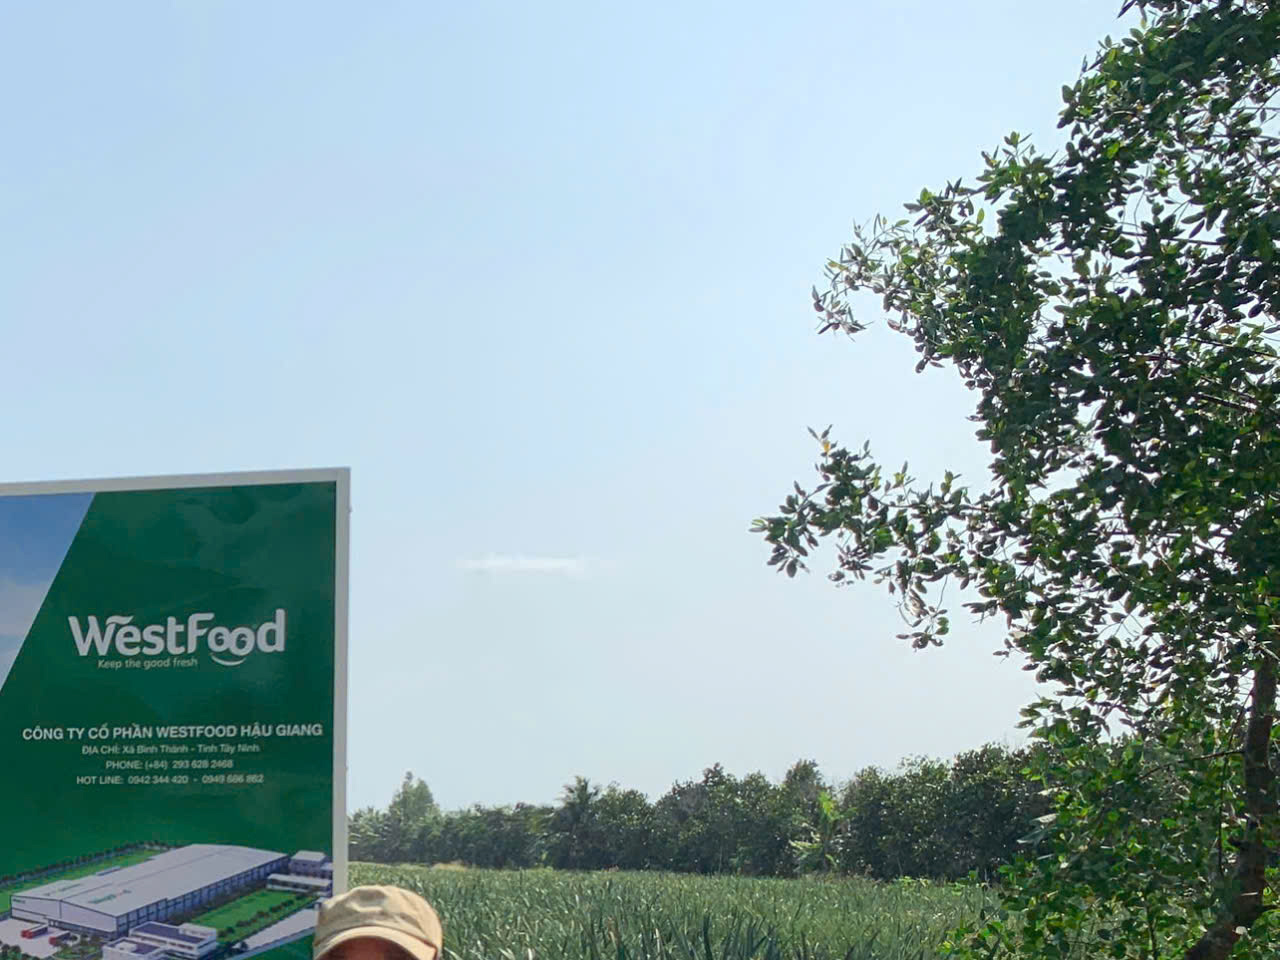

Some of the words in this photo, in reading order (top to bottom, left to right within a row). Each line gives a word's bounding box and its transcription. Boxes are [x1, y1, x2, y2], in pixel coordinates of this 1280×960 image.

[68, 608, 286, 657] WestFood
[97, 658, 122, 670] Keep
[125, 657, 141, 668] the
[143, 657, 171, 670] good
[173, 656, 198, 668] fresh
[22, 725, 64, 740] CÔNG
[67, 727, 85, 740] TY
[113, 722, 153, 739] PHẦN
[156, 724, 237, 739] WESTFOOD
[240, 721, 272, 739] HẬU
[276, 723, 323, 737] GIANG
[81, 745, 99, 756] ĐỊA
[105, 760, 143, 769] PHONE:
[144, 760, 168, 771] (+84)
[172, 759, 189, 769] 293
[76, 775, 96, 785] HOT
[99, 775, 124, 785] LINE:
[128, 775, 151, 785] 0942
[152, 775, 169, 785] 344
[171, 775, 189, 785] 420
